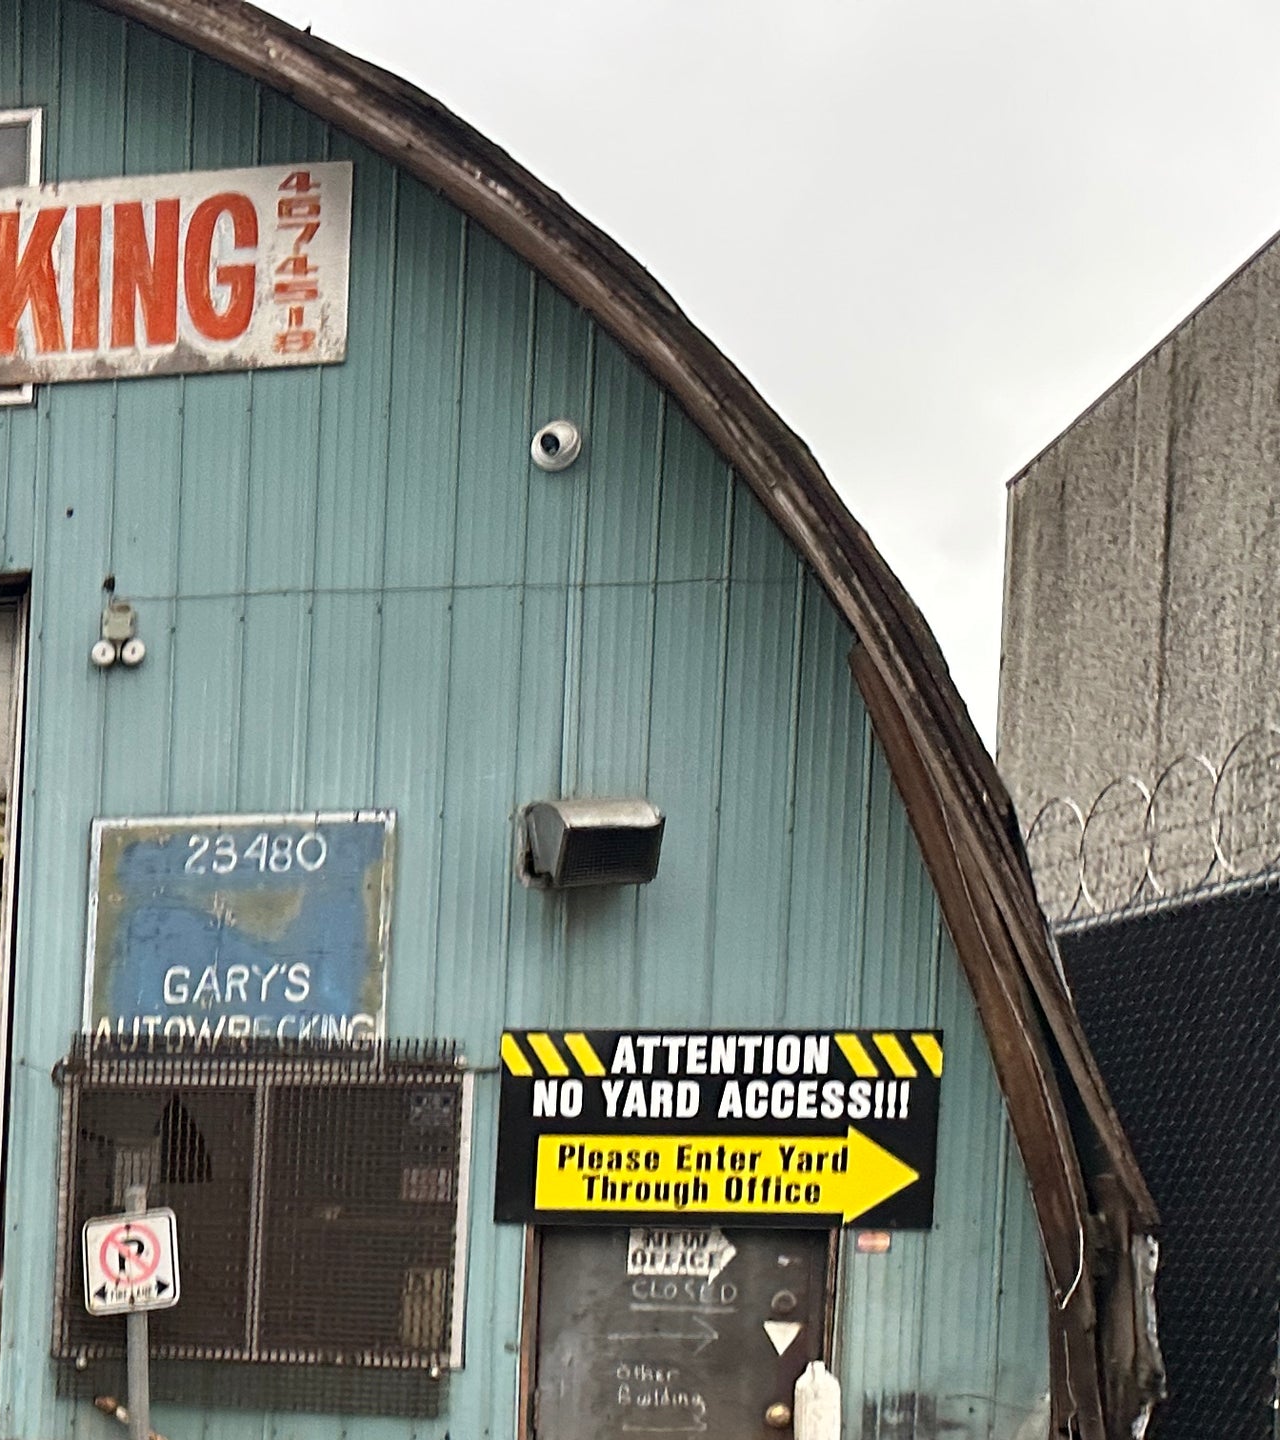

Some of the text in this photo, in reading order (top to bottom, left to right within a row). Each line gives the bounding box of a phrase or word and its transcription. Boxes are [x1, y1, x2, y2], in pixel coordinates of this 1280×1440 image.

[184, 832, 327, 875] 23480
[163, 962, 310, 1005] GARY'S
[611, 1035, 830, 1076] ATTENTION
[533, 1080, 910, 1120] NO YARD ACCESS!!!
[557, 1144, 848, 1174] Please Enter Yard
[582, 1174, 821, 1209] Through Office
